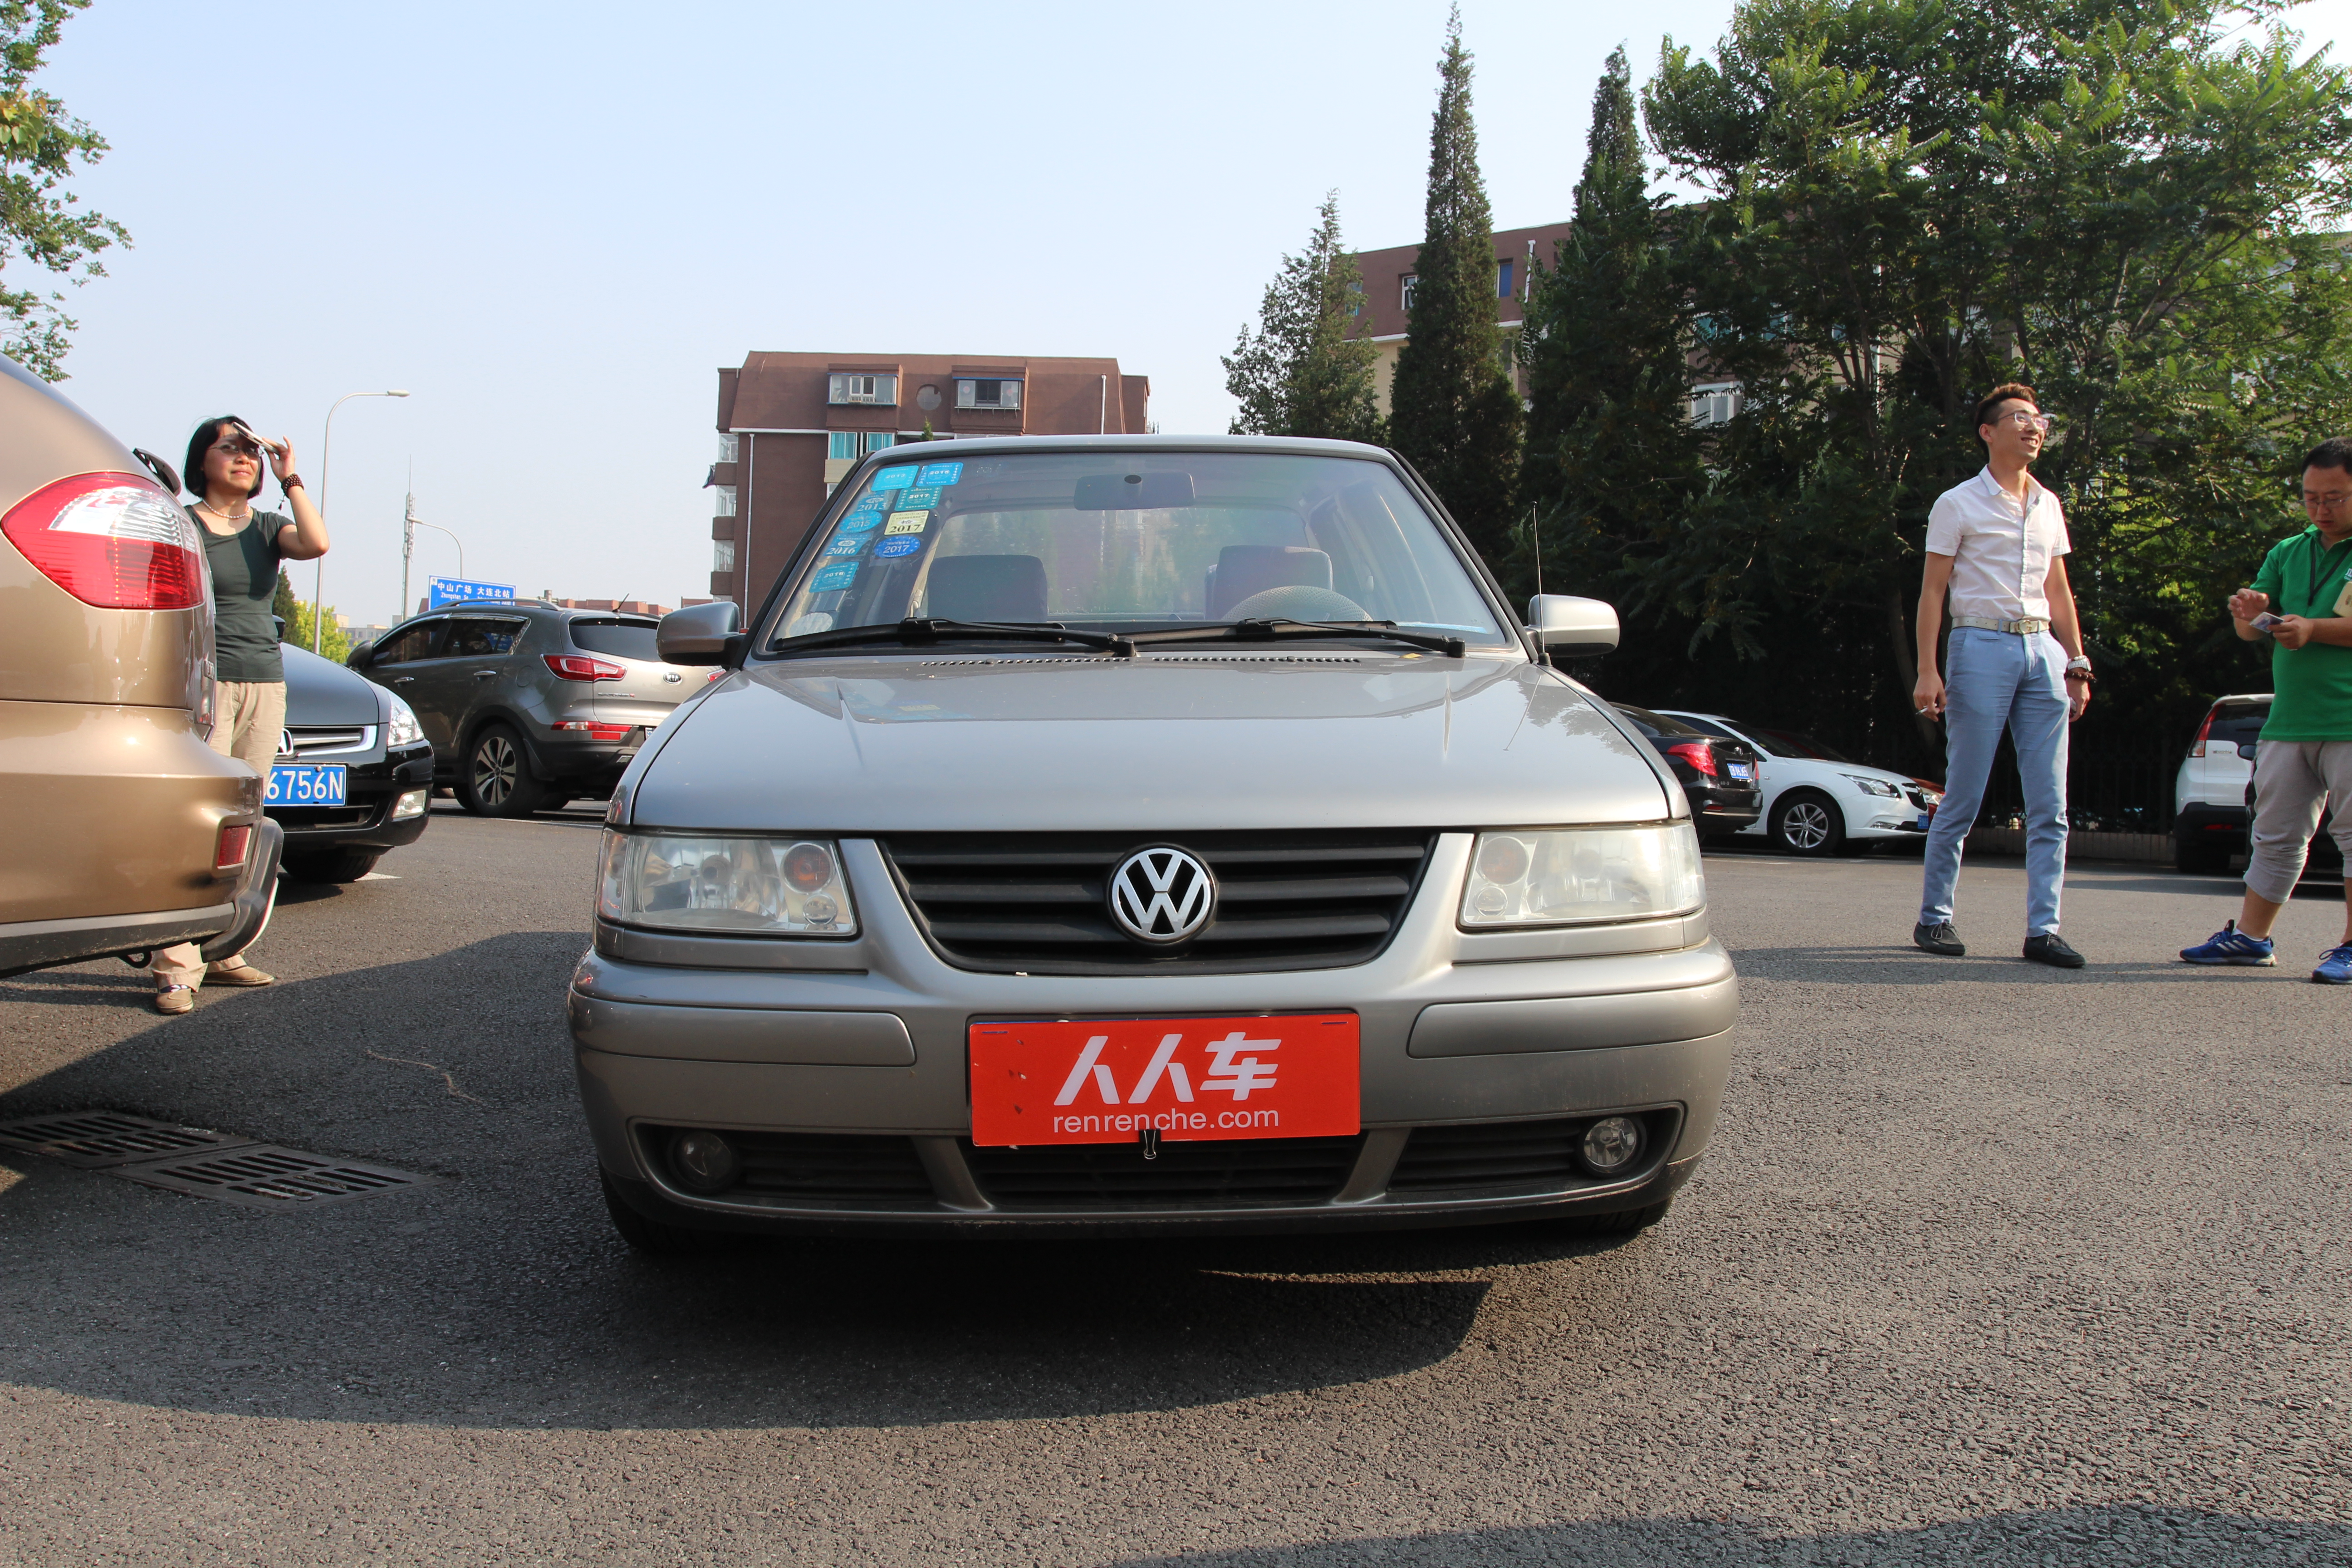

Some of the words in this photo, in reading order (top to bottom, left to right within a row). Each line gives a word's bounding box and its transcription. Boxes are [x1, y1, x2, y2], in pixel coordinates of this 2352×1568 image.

[857, 502, 887, 512] 2013
[847, 519, 871, 529] 2015
[889, 524, 921, 533] 2017
[826, 546, 856, 555] 2016
[883, 545, 910, 554] 2017
[437, 582, 472, 594] 中山广场
[477, 586, 510, 598] 大连北站
[441, 592, 461, 600] Zhongshan
[666, 674, 681, 682] KIA
[266, 770, 343, 800] 6756N
[1053, 1031, 1282, 1107] 人人车
[1054, 1107, 1280, 1134] renrenche.com
